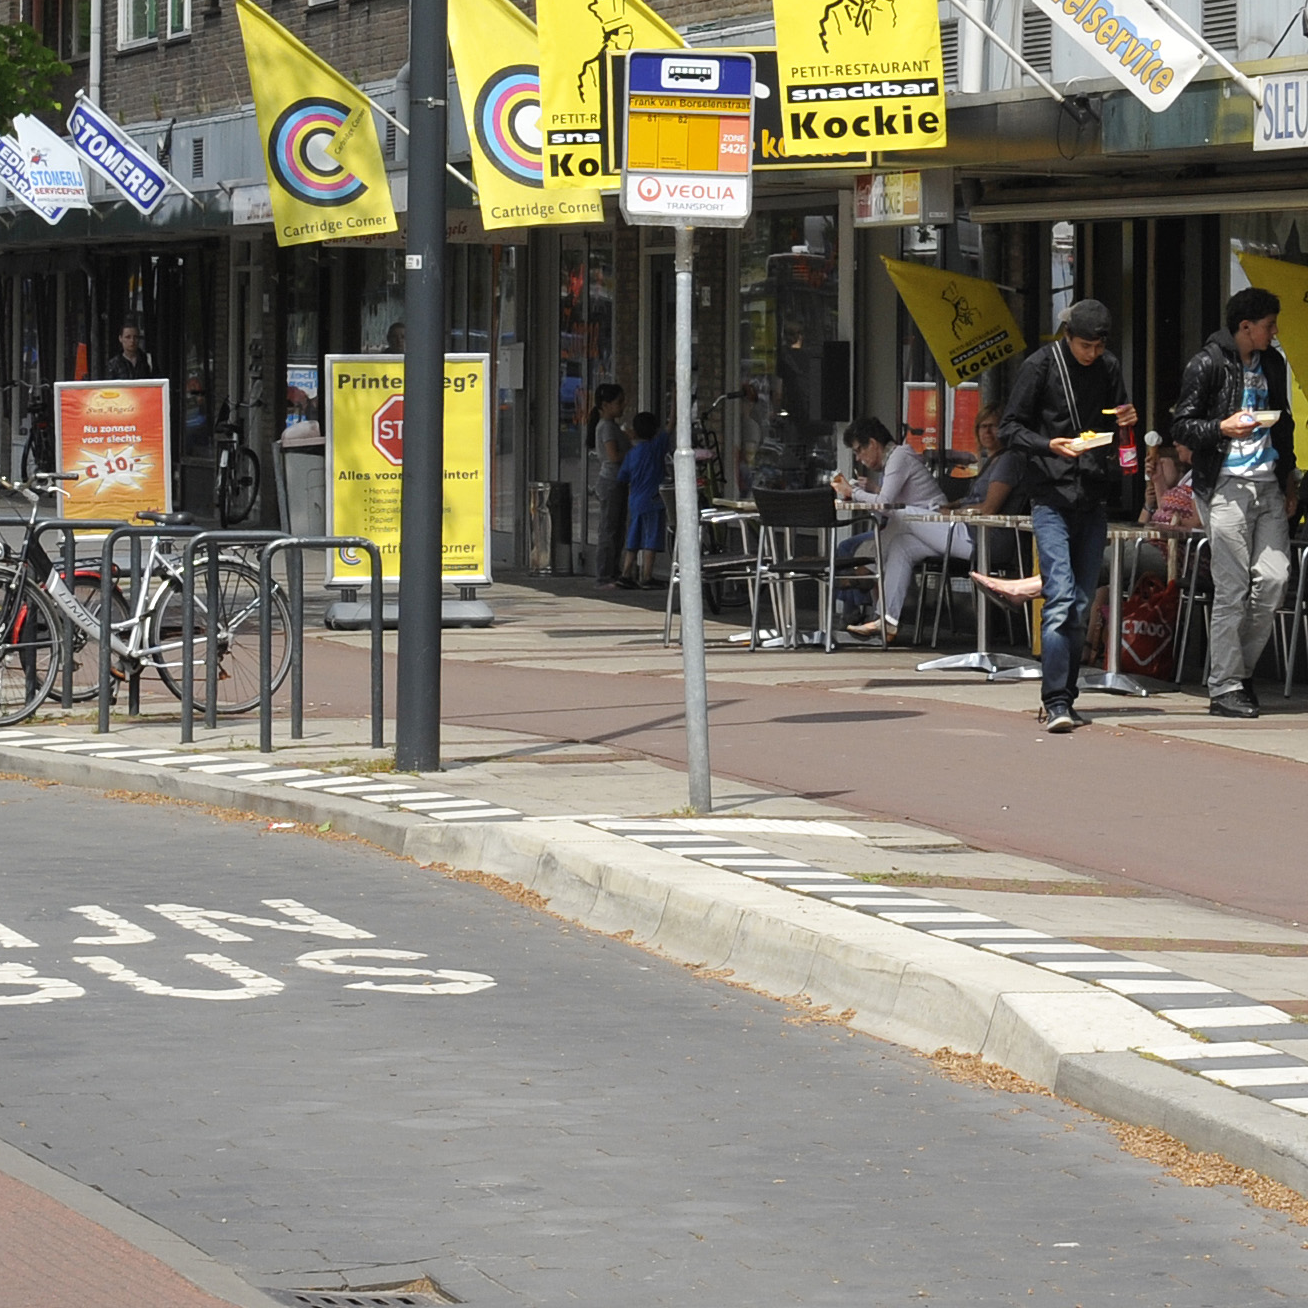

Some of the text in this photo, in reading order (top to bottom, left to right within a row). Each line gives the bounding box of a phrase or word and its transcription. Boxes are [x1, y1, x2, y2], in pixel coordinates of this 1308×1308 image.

[791, 60, 931, 78] PETIT-RESTAURANT
[791, 81, 935, 101] snackbar
[628, 96, 656, 107] Frank
[659, 99, 677, 107] van
[552, 113, 598, 125] PETIT-R
[790, 105, 940, 140] Kockie
[334, 128, 356, 155] Cartridge
[551, 132, 600, 144] sna
[723, 134, 745, 142] ZONE
[720, 144, 747, 154] 5426
[72, 114, 160, 202] STOMERIJ
[549, 153, 600, 177] Ko
[30, 170, 83, 187] STOMERIJ
[665, 184, 735, 200] VEOLIA
[491, 201, 603, 221] Cartridge Corner
[667, 202, 724, 211] TRANSPORT
[283, 215, 387, 238] Cartridge Corner
[952, 332, 1008, 364] snackbar
[956, 342, 1014, 380] Kockie
[338, 373, 478, 392] Printe eg?
[83, 425, 136, 433] Nu zonnen
[380, 420, 404, 440] ST
[82, 434, 142, 444] voor slechts
[105, 457, 141, 474] 10,-
[338, 470, 479, 480] Alles voor inter!
[369, 507, 402, 515] Compat
